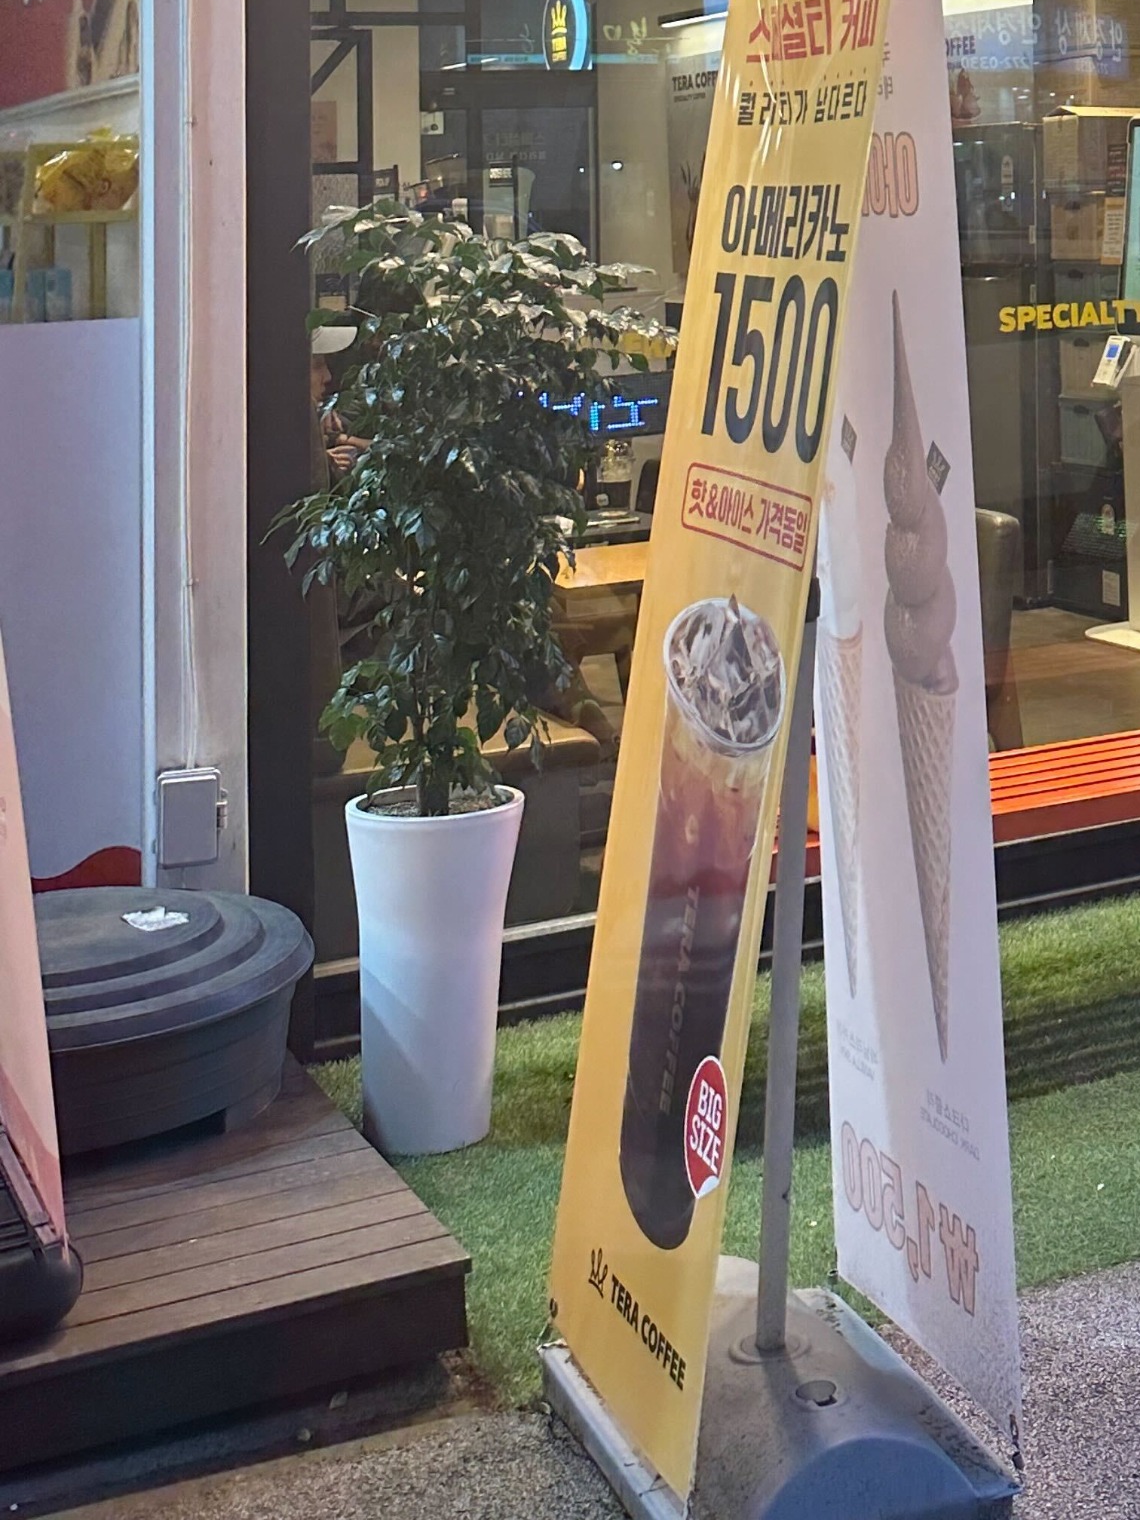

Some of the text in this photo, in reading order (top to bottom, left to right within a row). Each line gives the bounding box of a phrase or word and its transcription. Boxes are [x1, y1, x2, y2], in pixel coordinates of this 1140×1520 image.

[672, 70, 719, 91] TERA COFF
[814, 78, 868, 123] 남다르다
[721, 184, 850, 262] 아메리카노
[700, 272, 838, 465] 1500
[688, 477, 809, 555] 핫&아이스 가격동일
[698, 1079, 724, 1132] BIG
[689, 1117, 723, 1173] SIZE
[610, 1274, 686, 1392] TERA COFFEE
